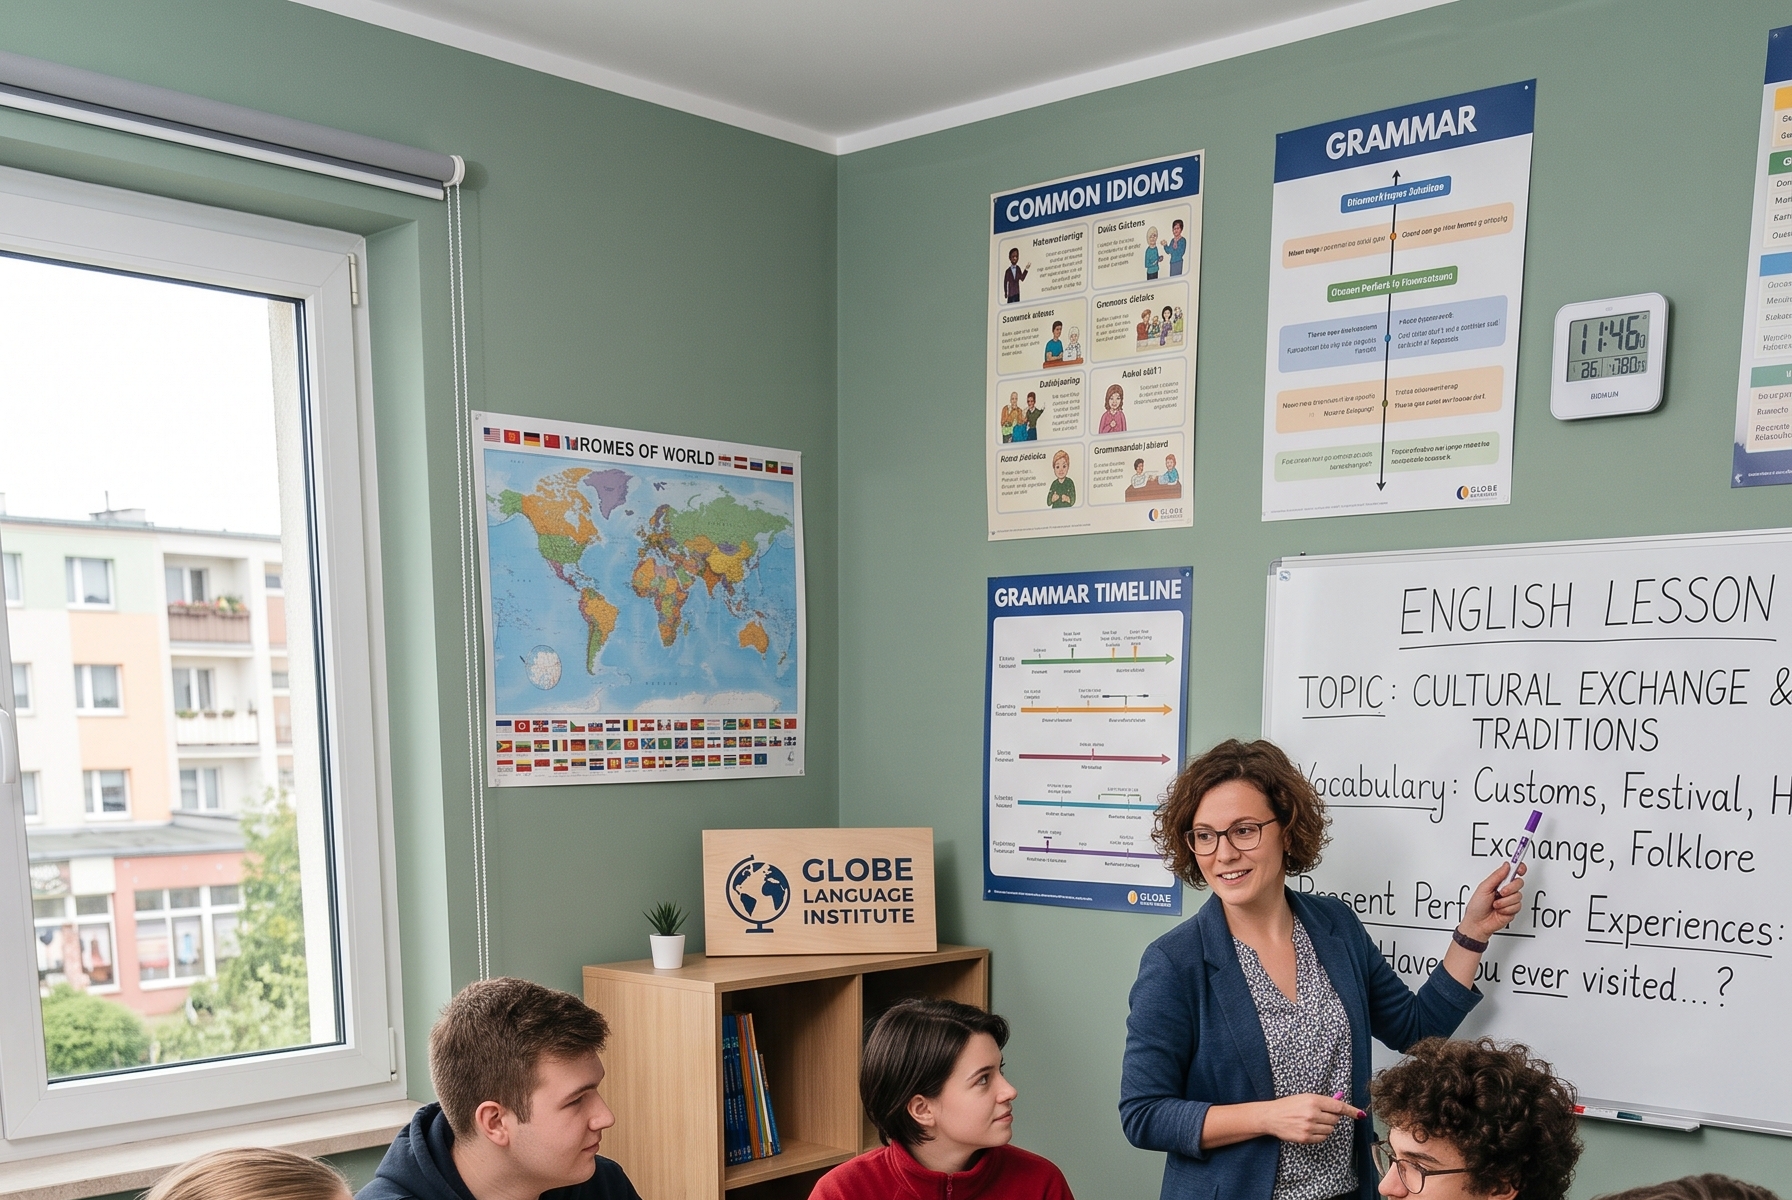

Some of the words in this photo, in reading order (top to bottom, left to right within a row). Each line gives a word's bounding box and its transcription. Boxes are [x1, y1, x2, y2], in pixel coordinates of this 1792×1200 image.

[1325, 105, 1478, 160] GRAMMAR
[1005, 183, 1101, 223] COMMON
[1106, 166, 1184, 204] IDIOMS
[1581, 314, 1641, 355] 11:46
[639, 443, 659, 459] OF
[662, 446, 715, 466] WORLD
[1470, 485, 1498, 493] GLOBE
[994, 584, 1090, 608] GRAMMAR
[1094, 579, 1182, 603] TIMELINE
[1400, 581, 1572, 636] ENGLISH
[1604, 574, 1776, 627] LESSON
[1413, 671, 1562, 708] CULTURAL
[1579, 668, 1750, 706] EXCHANGE
[1769, 667, 1792, 706] &
[1472, 717, 1660, 753] TRADITIONS
[1473, 765, 1607, 816] Customs,
[1622, 771, 1754, 821] Festival,
[802, 857, 914, 883] GLOBE
[1630, 830, 1756, 873] Folklore
[803, 887, 915, 904] LANGUAGE
[1299, 874, 1397, 917] Psent
[1530, 890, 1571, 930] for
[1587, 894, 1785, 950] Experiences:
[803, 908, 915, 925] INSTITUTE
[1473, 961, 1501, 983] ou
[1511, 964, 1570, 989] ever
